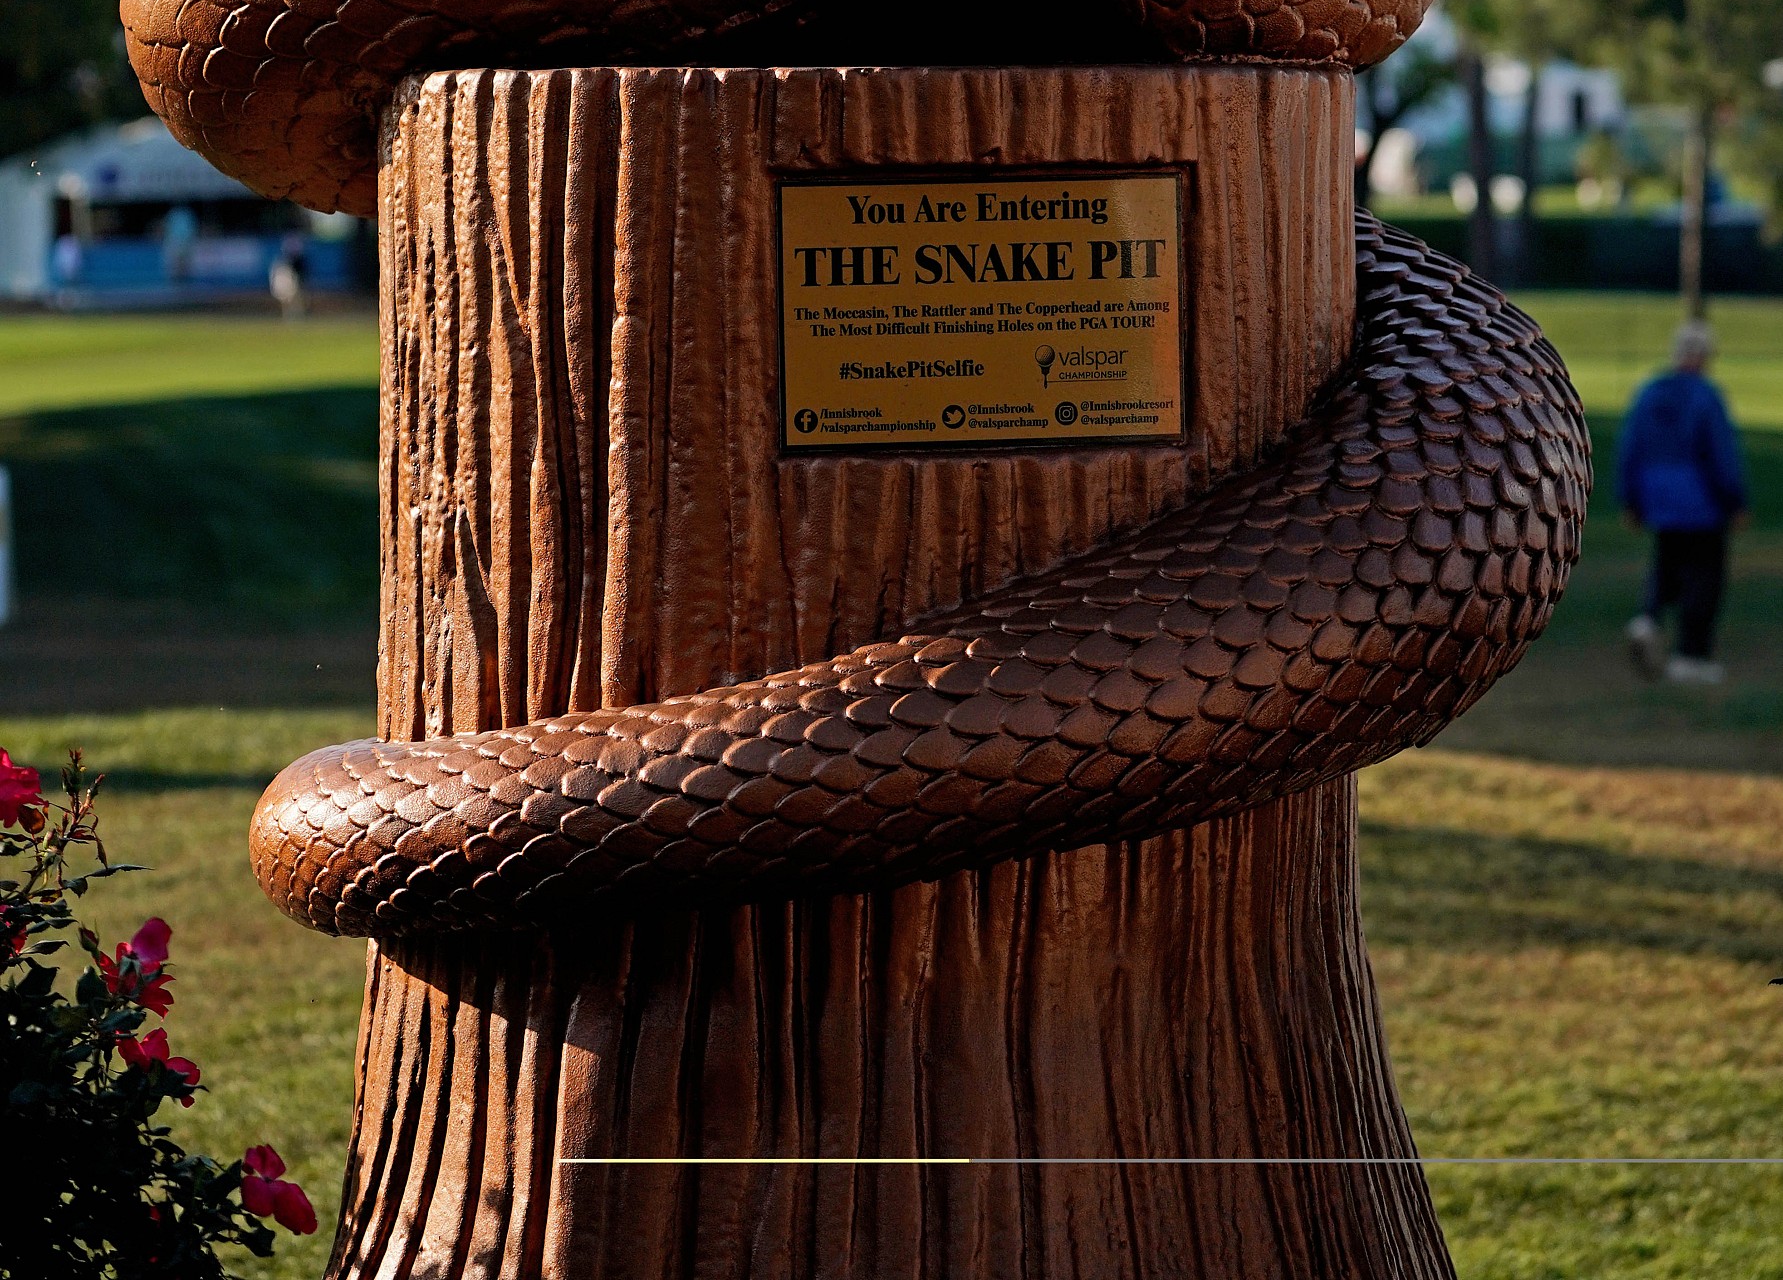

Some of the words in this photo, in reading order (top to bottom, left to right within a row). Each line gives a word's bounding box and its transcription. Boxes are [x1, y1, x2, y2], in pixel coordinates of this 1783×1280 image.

[847, 195, 906, 224] You
[915, 194, 967, 223] Are
[975, 191, 1108, 224] Entering
[794, 245, 900, 287] THE
[914, 241, 1075, 285] SNAKE
[1087, 239, 1166, 280] PIT
[794, 307, 820, 320] The
[823, 306, 889, 320] Moccasin,
[892, 305, 918, 318] The
[921, 304, 966, 317] Rattler
[969, 304, 993, 316] and
[997, 303, 1022, 315] The
[1025, 301, 1100, 316] Copperhead
[1104, 302, 1124, 312] are
[1127, 300, 1169, 312] Among
[810, 324, 835, 336] The
[839, 323, 872, 336] Most
[876, 322, 930, 335] Difficult
[933, 320, 994, 335] Finishing
[997, 319, 1034, 332] Holes
[1037, 321, 1053, 331] on
[1057, 318, 1077, 330] the
[1080, 317, 1107, 329] PGA
[1111, 315, 1155, 328] TOUR!
[1059, 346, 1126, 370] valspar
[839, 359, 985, 380] #SnakePitSelfie
[1059, 371, 1128, 380] CHAMPIONSHIP
[820, 407, 882, 419] /Innisbrook
[968, 403, 1034, 415] @Innisbrook
[820, 420, 936, 434] /valsparchampionship
[968, 417, 1048, 430] @valsparchamp
[1081, 414, 1159, 426] @valsparchamp
